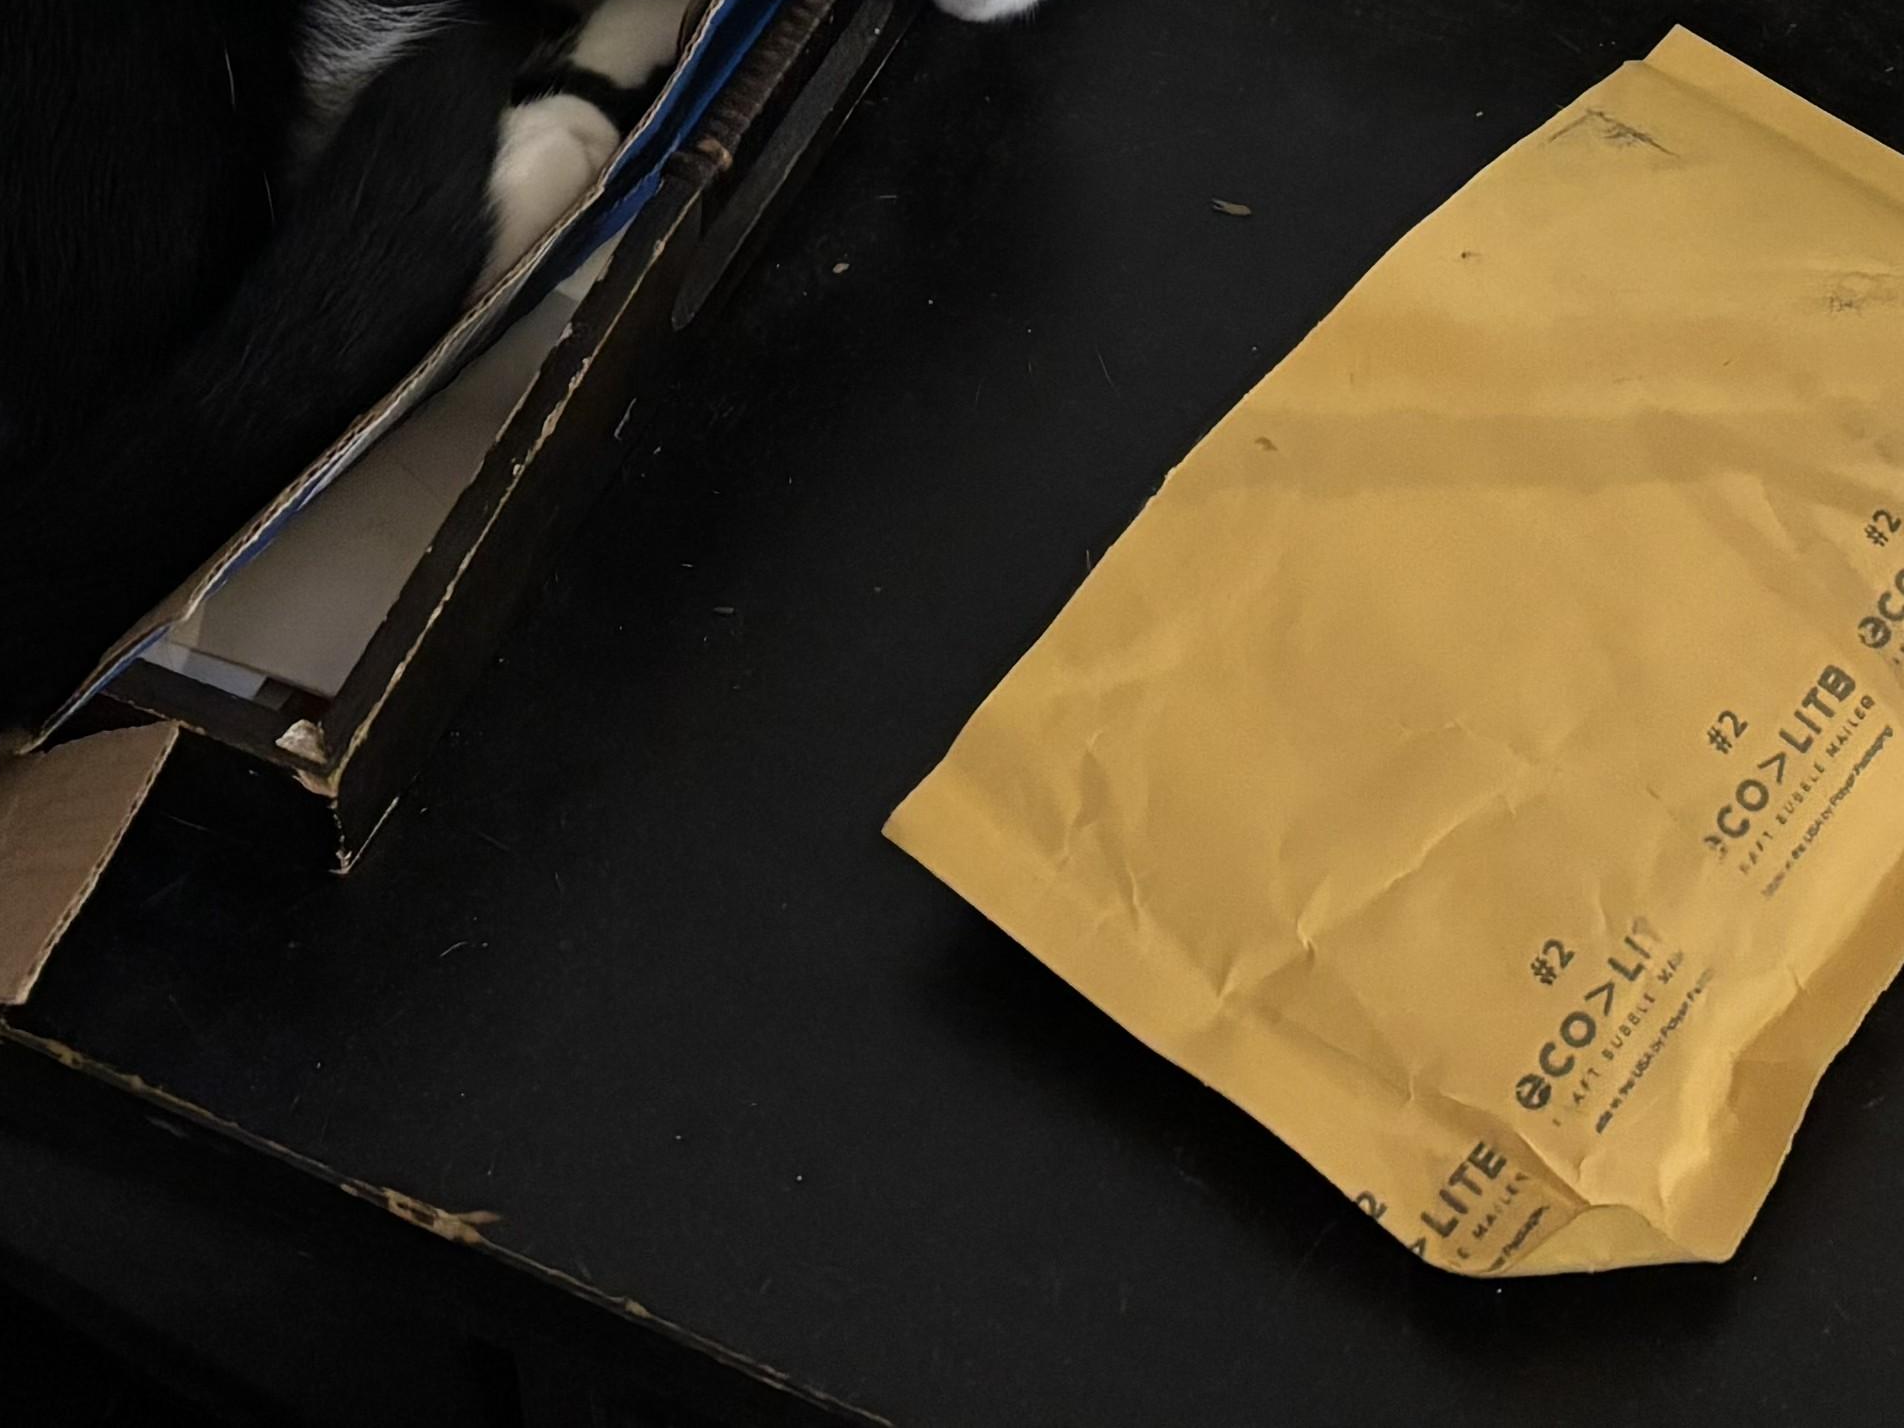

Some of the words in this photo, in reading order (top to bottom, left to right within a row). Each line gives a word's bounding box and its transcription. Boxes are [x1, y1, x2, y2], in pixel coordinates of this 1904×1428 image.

[1865, 510, 1901, 546] #2
[1708, 711, 1748, 754] #2
[1531, 940, 1574, 986] #2
